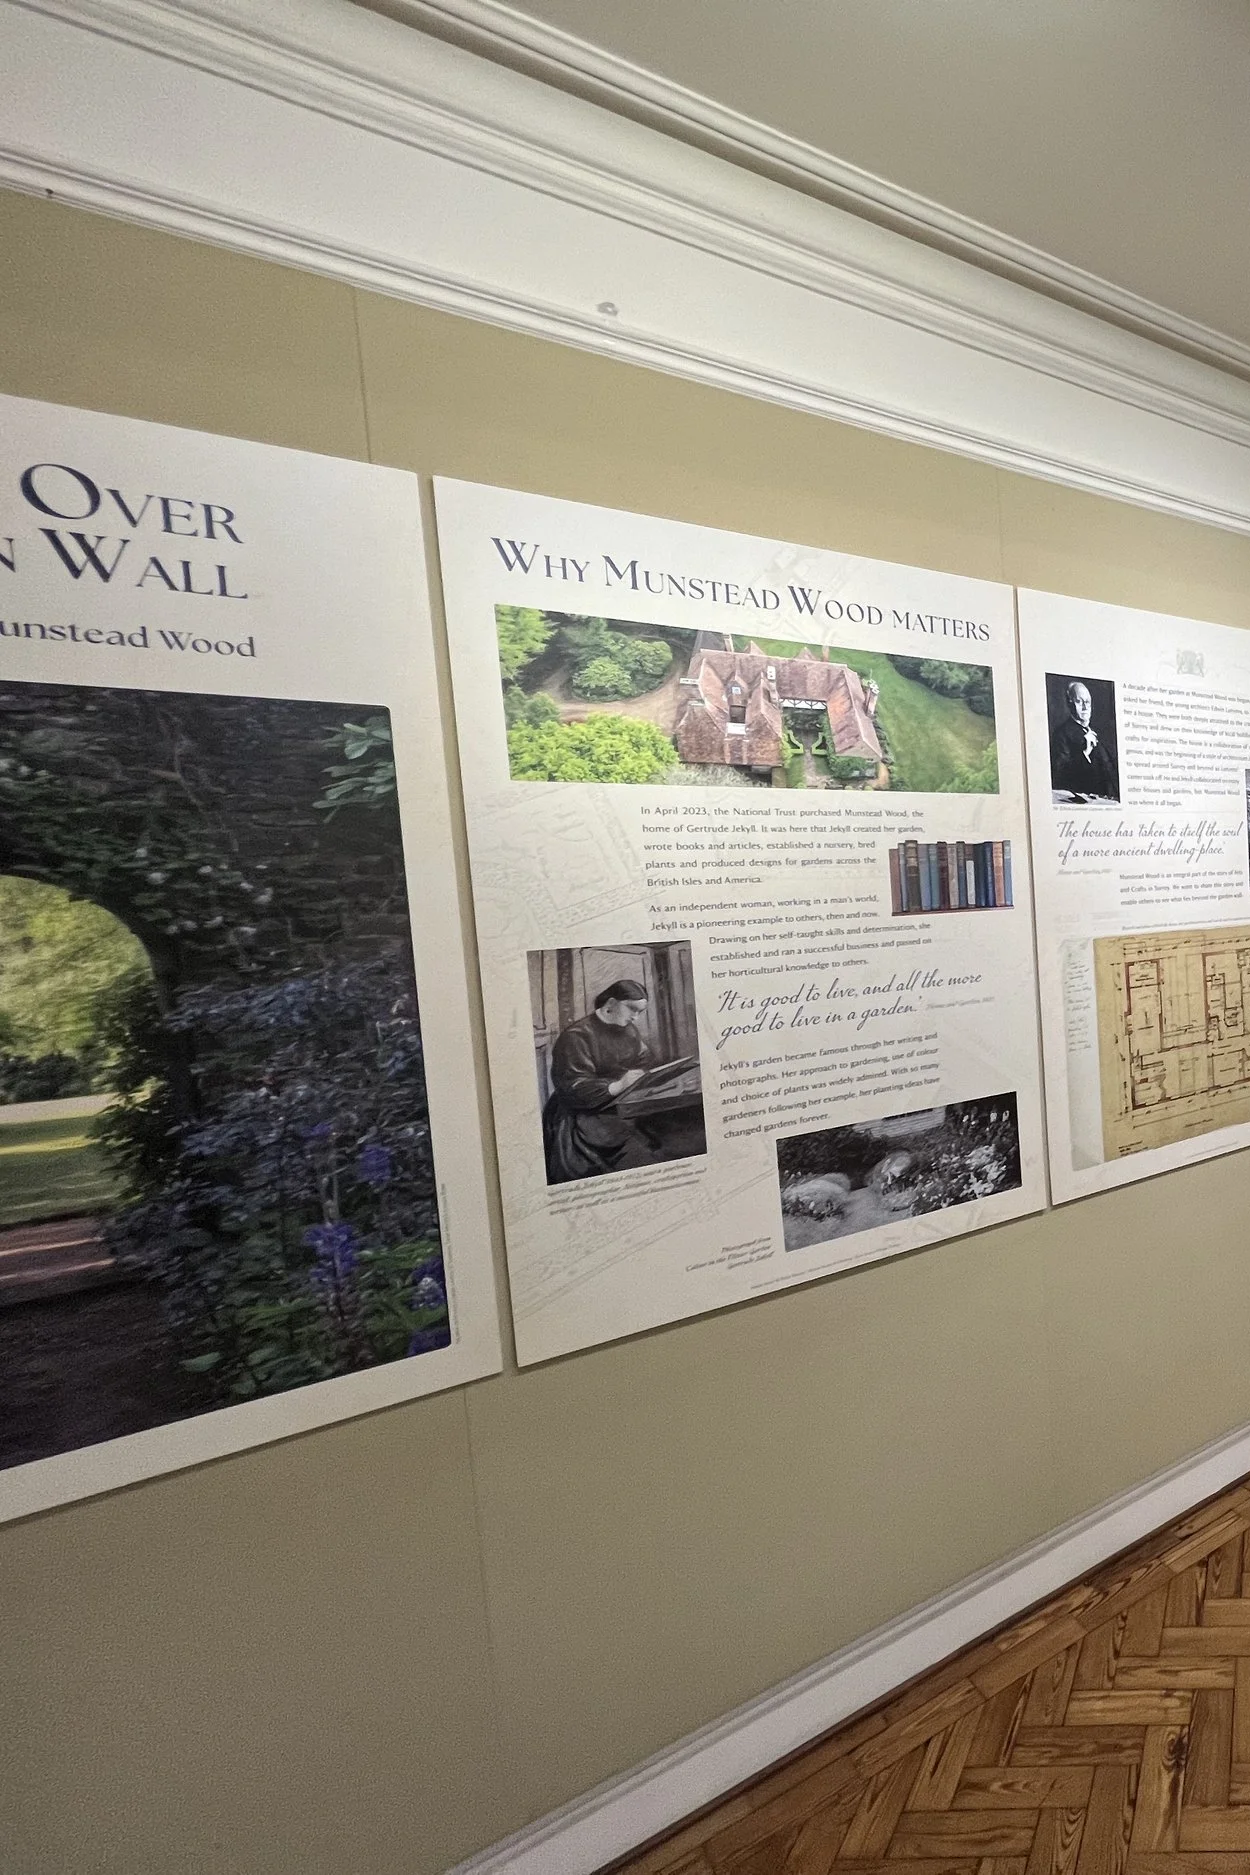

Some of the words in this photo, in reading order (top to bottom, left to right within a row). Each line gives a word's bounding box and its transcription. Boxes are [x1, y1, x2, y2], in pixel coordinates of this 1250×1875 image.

[20, 463, 245, 544] OVER
[38, 528, 249, 599] WALL
[491, 536, 590, 582] WHY
[602, 555, 780, 610] MUNSTEAD
[788, 585, 883, 626] WOOD
[891, 609, 991, 642] MATTERS
[0, 620, 150, 649] unstead
[158, 630, 257, 658] Wood
[641, 806, 650, 816] In
[654, 806, 678, 818] April
[714, 807, 729, 816] the
[734, 807, 771, 817] National
[775, 807, 796, 817] Trust
[800, 808, 841, 819] purchased
[845, 808, 882, 818] Munstead
[642, 823, 670, 833] home
[673, 823, 684, 833] of
[687, 823, 729, 833] Gertrude
[761, 824, 768, 833] It
[789, 824, 807, 833] here
[810, 824, 827, 833] that
[829, 824, 850, 836] Jekyll
[1081, 821, 1113, 838] house
[1114, 821, 1134, 838] has
[1138, 821, 1165, 838] taken
[1167, 822, 1178, 837] to
[1179, 820, 1206, 845] itself
[1205, 821, 1221, 837] the
[1222, 820, 1243, 837] soul
[643, 841, 672, 851] wrote
[676, 841, 704, 851] books
[708, 841, 725, 850] and
[767, 840, 813, 850] established
[1058, 839, 1074, 865] of
[1073, 849, 1080, 857] a
[1083, 848, 1110, 857] more
[1112, 843, 1152, 857] ancient
[1153, 839, 1196, 863] dwelling
[645, 859, 675, 872] plants
[680, 858, 698, 868] and
[702, 858, 745, 871] produced
[748, 858, 782, 869] designs
[785, 857, 797, 866] for
[801, 857, 832, 869] gardens
[836, 858, 860, 866] across
[647, 877, 679, 887] British
[682, 876, 702, 886] Isles
[705, 876, 722, 885] and
[648, 903, 661, 913] As
[680, 900, 738, 914] independent
[778, 897, 811, 909] working
[813, 897, 821, 906] in
[823, 898, 828, 906] a
[830, 895, 853, 905] man's
[651, 920, 677, 933] Jekyll
[680, 920, 687, 929] is
[689, 921, 694, 929] a
[697, 917, 745, 931] pioneering
[747, 914, 782, 927] example
[785, 913, 794, 923] to
[826, 911, 844, 921] then
[846, 910, 860, 920] and
[709, 934, 747, 946] Drawing
[762, 932, 776, 941] her
[779, 928, 823, 940] self-taught
[825, 927, 844, 937] skills
[847, 926, 860, 936] and
[710, 948, 761, 962] established
[763, 947, 779, 957] and
[781, 948, 795, 956] ran
[804, 942, 844, 954] successful
[846, 942, 878, 951] business
[711, 969, 726, 979] her
[729, 964, 783, 978] horticultural
[832, 960, 840, 968] to
[740, 997, 754, 1009] is
[755, 983, 805, 1020] good
[806, 984, 821, 1002] to
[826, 978, 858, 999] live,
[862, 974, 896, 995] and
[896, 968, 922, 991] all
[921, 968, 944, 988] the
[948, 974, 982, 986] more
[716, 1012, 768, 1050] good
[769, 1012, 785, 1031] to
[791, 1005, 821, 1028] live
[826, 1012, 843, 1023] in
[847, 1011, 858, 1020] a
[719, 1059, 750, 1073] Jekyll's
[752, 1056, 782, 1069] garden
[785, 1051, 816, 1062] became
[781, 1070, 797, 1078] Her
[799, 1062, 837, 1077] approach
[721, 1095, 738, 1106] and
[741, 1092, 769, 1102] choice
[772, 1088, 782, 1097] of
[784, 1084, 809, 1097] plants
[722, 1108, 766, 1124] gardeners
[768, 1101, 807, 1113] following
[724, 1124, 761, 1139] changed
[764, 1119, 797, 1133] gardens
